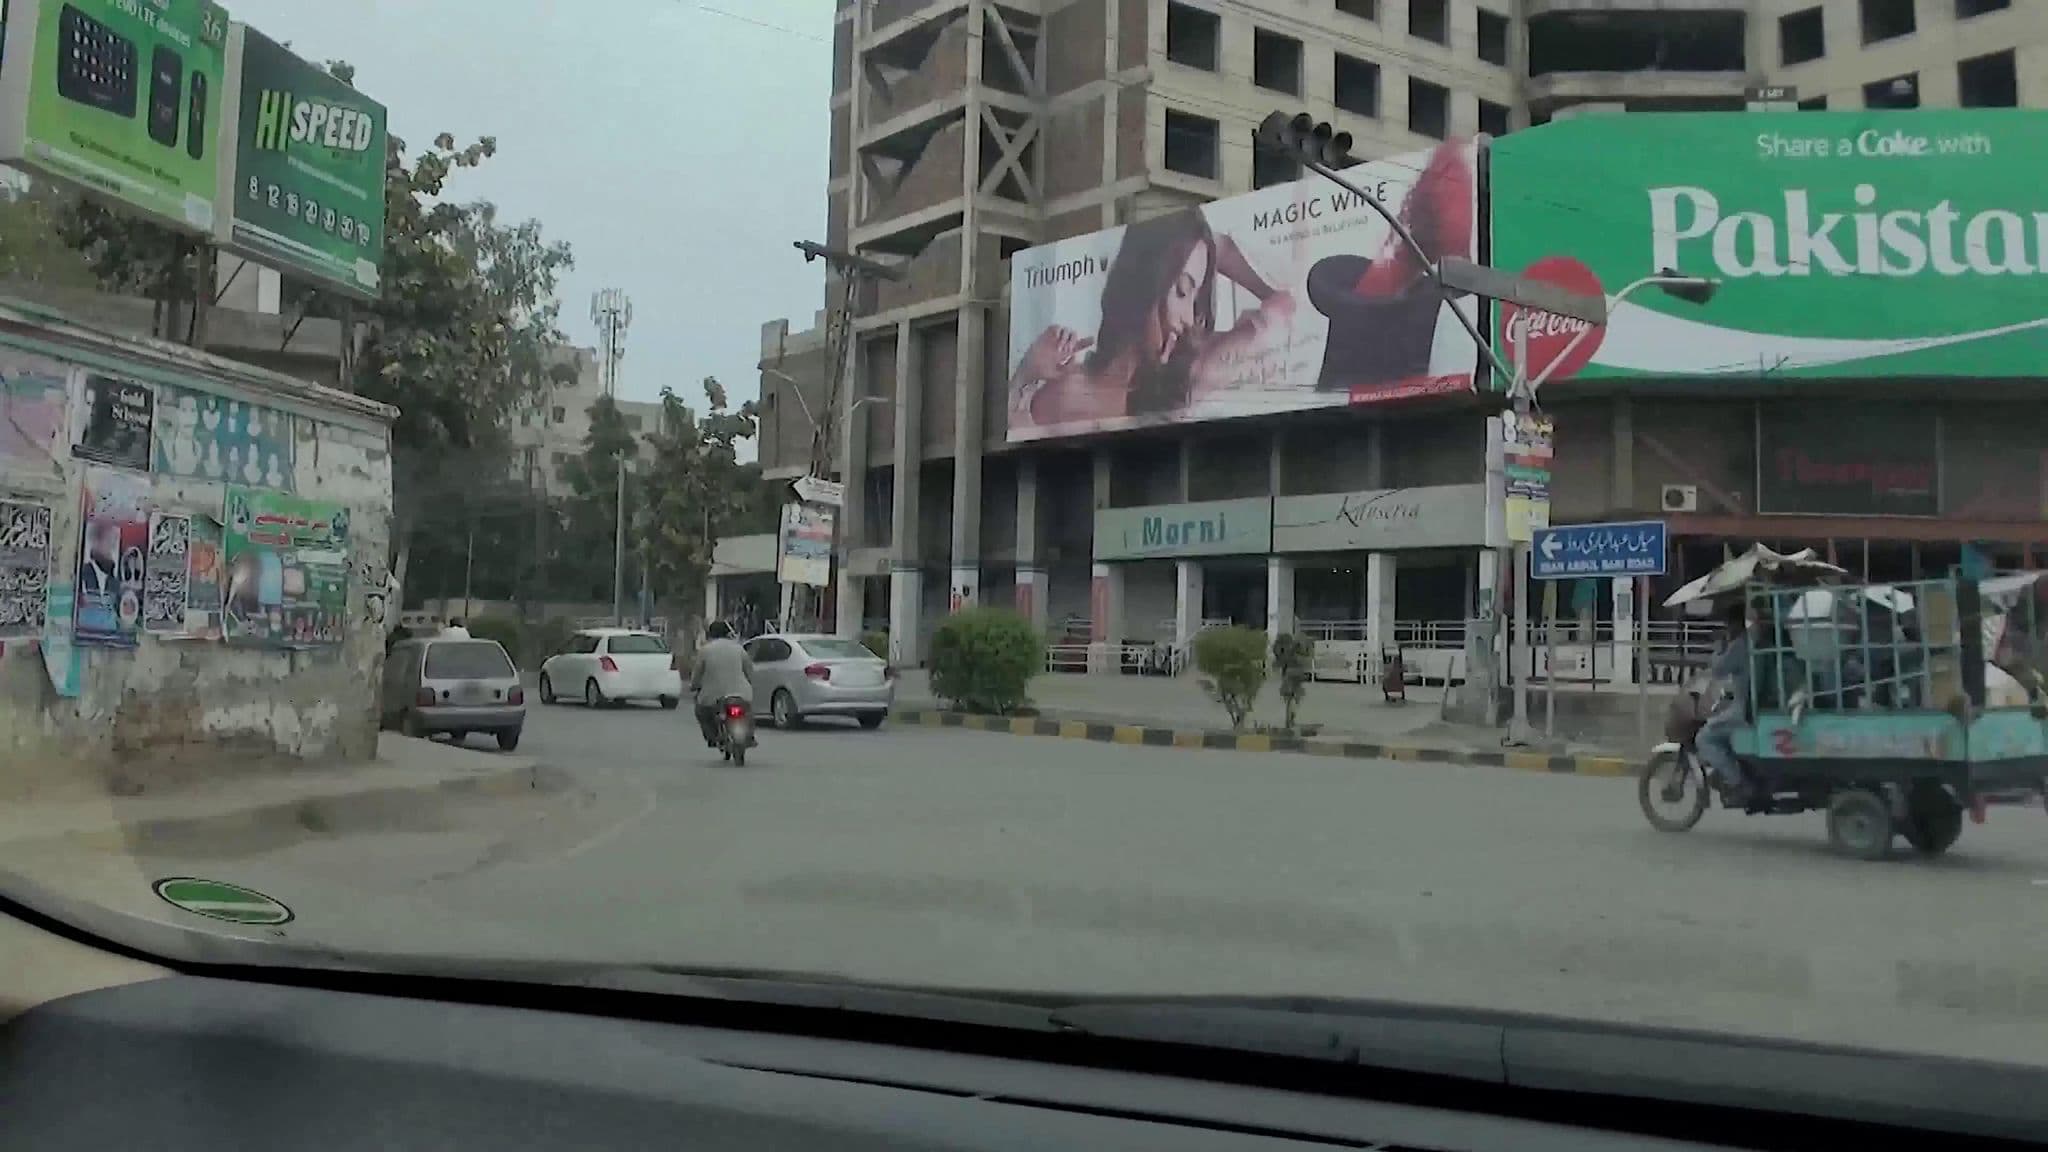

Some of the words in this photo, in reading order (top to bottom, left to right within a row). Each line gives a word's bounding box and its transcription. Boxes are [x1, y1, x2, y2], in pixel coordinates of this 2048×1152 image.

[1757, 132, 1830, 157] Share
[1838, 140, 1852, 156] a
[1857, 129, 1929, 157] Coke
[1936, 134, 1992, 156] with
[1253, 199, 1322, 232] MAGIC
[1024, 255, 1094, 289] Triumph
[1627, 557, 1656, 569] ROAD
